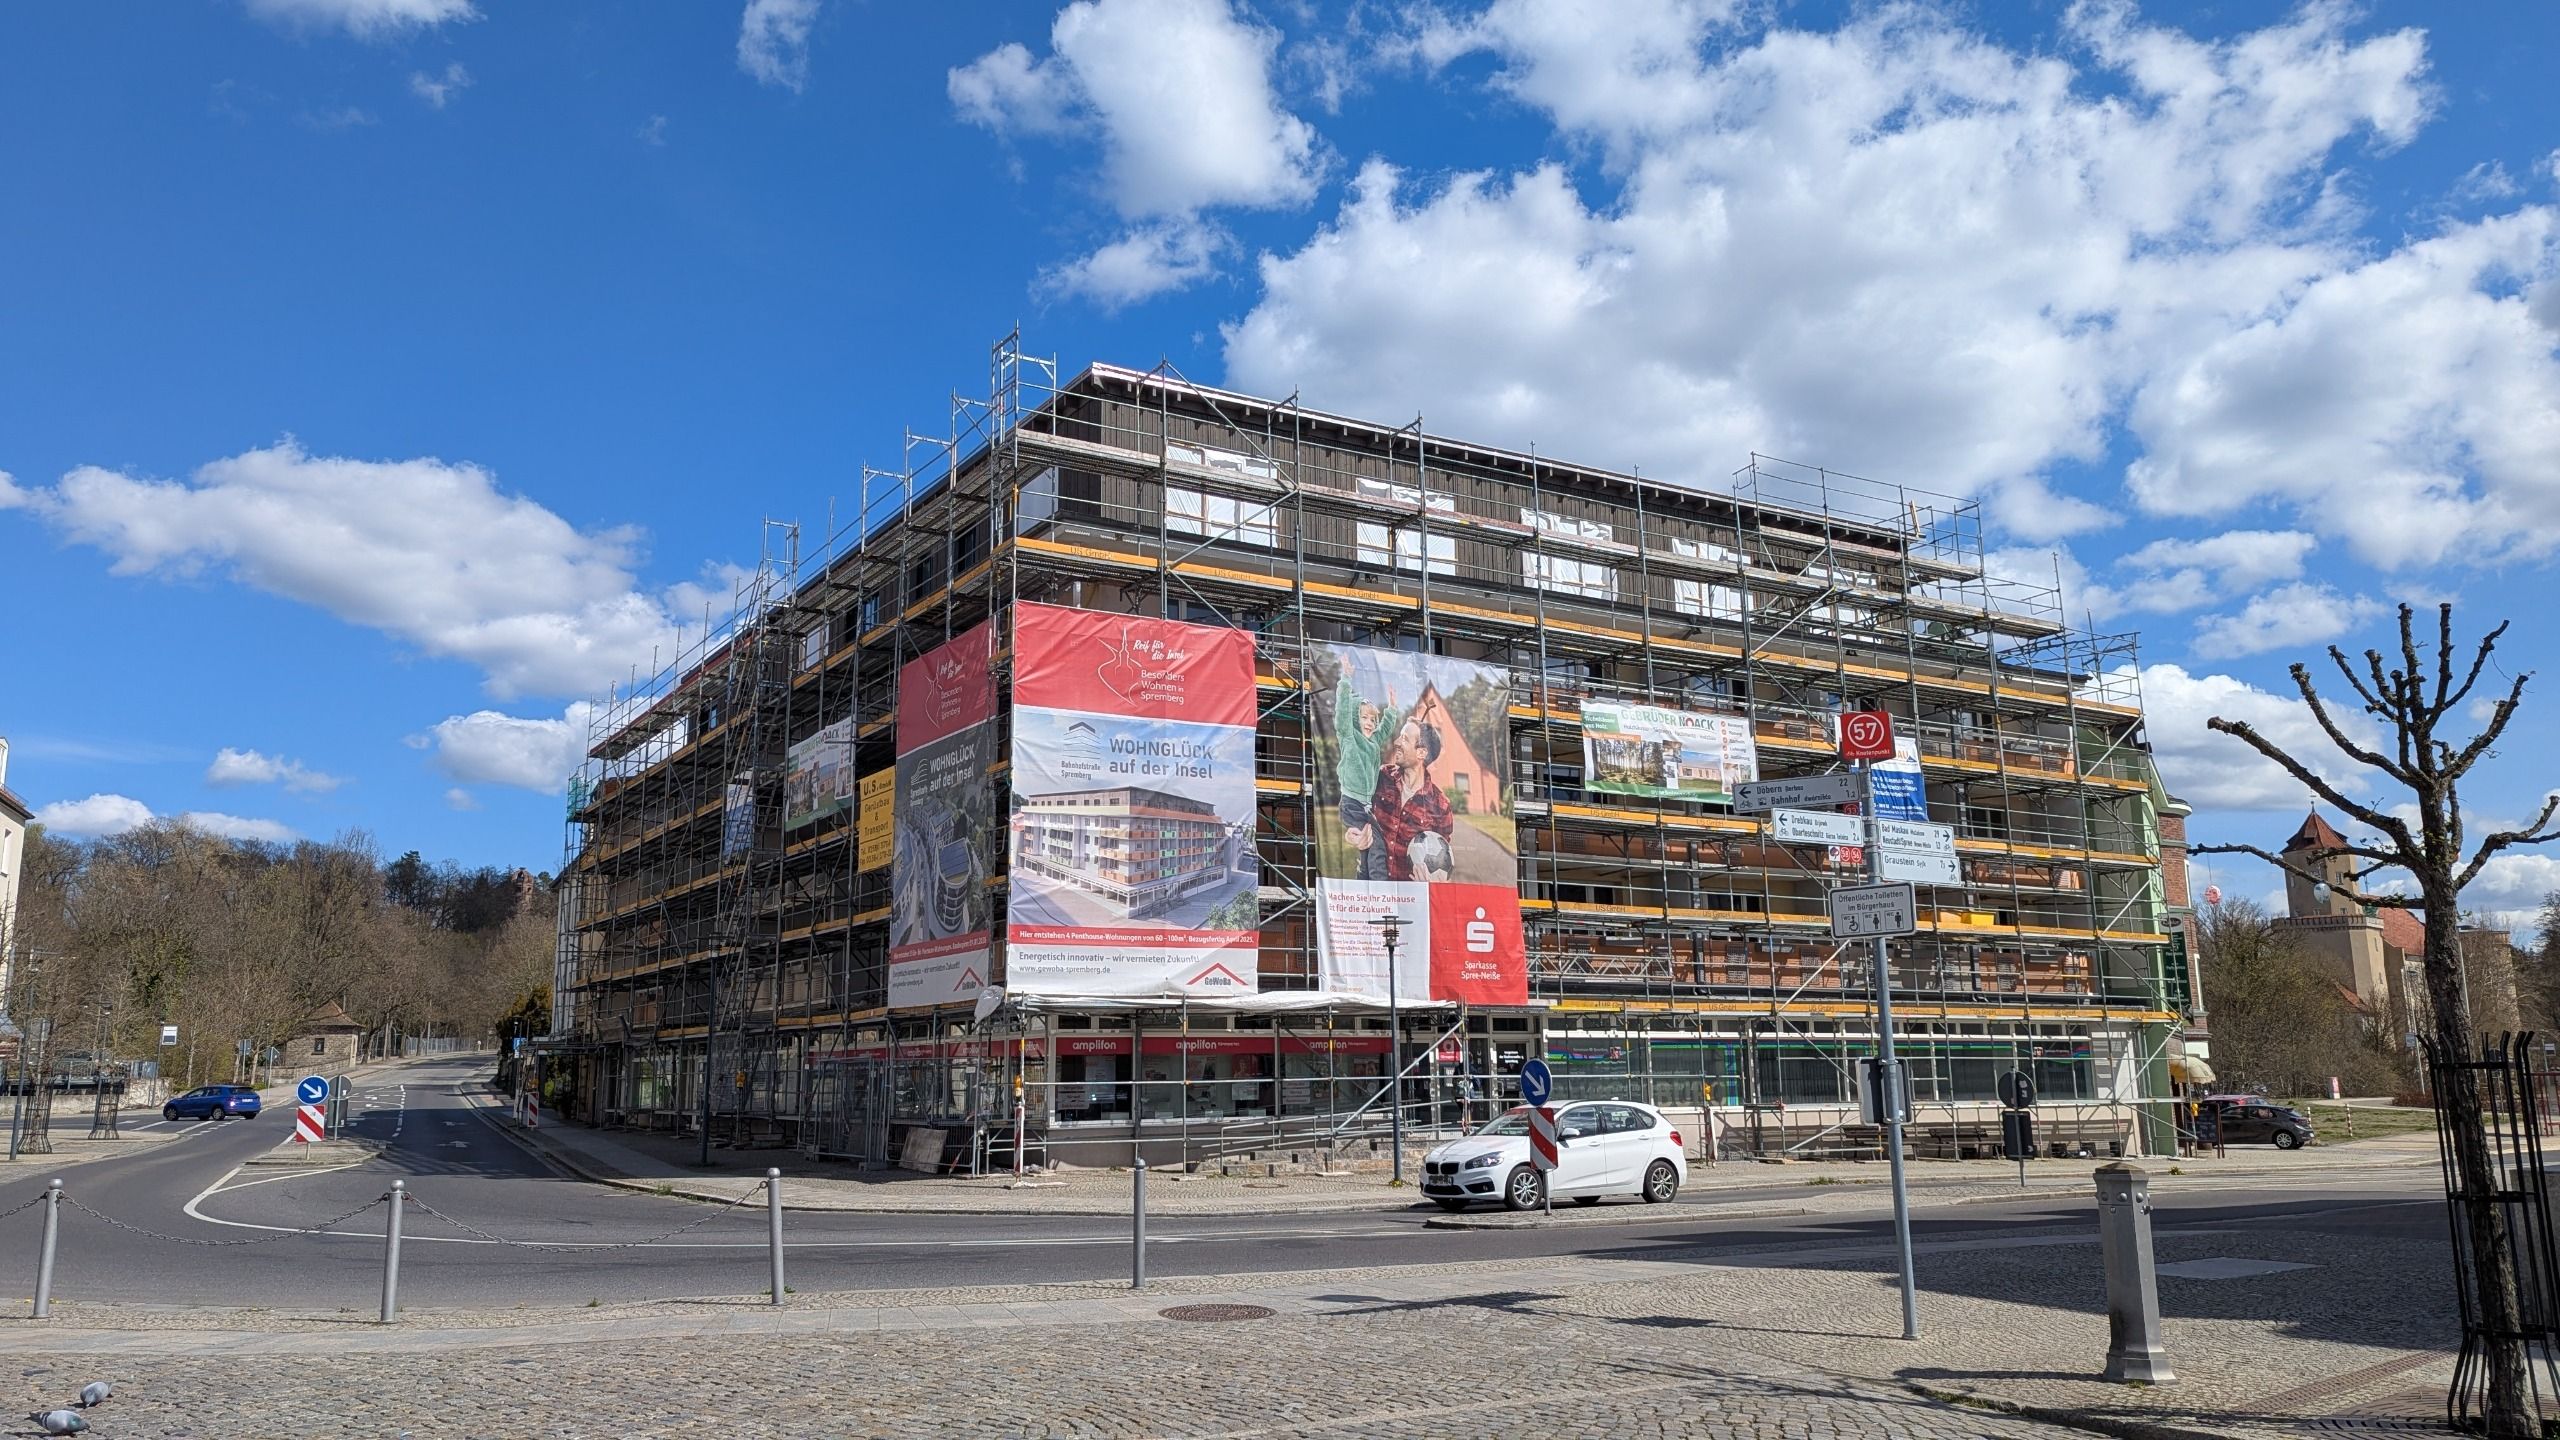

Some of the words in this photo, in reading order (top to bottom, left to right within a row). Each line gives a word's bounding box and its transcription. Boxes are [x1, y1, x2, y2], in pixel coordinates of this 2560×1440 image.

[1141, 669, 1185, 682] Besonders
[1141, 680, 1177, 692] Wohnen
[1140, 691, 1185, 705] Spremberg
[1621, 708, 1677, 726] GEBRÜDER
[1679, 714, 1714, 731] NOACK
[1853, 722, 1877, 741] 57
[1109, 738, 1213, 760] WOHNGLÜCK
[1856, 749, 1890, 757] Knotenpunkt
[930, 743, 976, 774] WOHNGLÜCK
[1061, 760, 1101, 771] Bahnhofstraße
[1109, 758, 1135, 774] auf
[1141, 760, 1169, 776] der
[1175, 762, 1213, 779] Insel
[930, 774, 942, 792] auf
[942, 771, 955, 787] der
[956, 761, 974, 782] Insel
[1061, 770, 1092, 781] Spremberg
[1756, 786, 1782, 795] Döbern
[1839, 778, 1848, 787] 22
[1771, 795, 1800, 805] Bahnhof
[1792, 815, 1813, 826] Drebkau
[864, 821, 889, 835] Transport
[1881, 823, 1890, 832] Bad
[1891, 825, 1909, 835] Muskau
[1884, 855, 1914, 866] Graustein
[1356, 894, 1368, 902] Sie
[1381, 895, 1416, 904] Zuhause
[1838, 894, 1873, 903] Öffentliche
[1874, 891, 1904, 899] Toiletten
[1336, 904, 1347, 912] für
[1348, 905, 1360, 913] die
[1361, 905, 1394, 914] Zukunft.
[1856, 902, 1895, 911] Bürgerhaus
[1019, 930, 1032, 938] Hier
[1033, 931, 1065, 939] entstehen
[1066, 931, 1070, 939] 4
[1071, 932, 1141, 942] Penthouse-Wohnungen
[1188, 935, 1225, 943] Bezugsfertig
[1226, 936, 1240, 944] April
[1019, 951, 1065, 962] Energetisch
[1067, 952, 1104, 962] innovativ
[1112, 954, 1124, 963] wir
[1126, 954, 1166, 963] vermieten
[1167, 954, 1200, 963] Zukunft!
[1019, 964, 1111, 974] www.gewoba-spremberg.de
[1464, 960, 1497, 970] Sparkasse
[1204, 976, 1232, 986] GeWoBa
[1461, 970, 1501, 980] Spree-Neiße
[1072, 1039, 1117, 1052] amplifon
[1175, 1039, 1217, 1052] amplifon
[1310, 1040, 1347, 1051] ampfon
